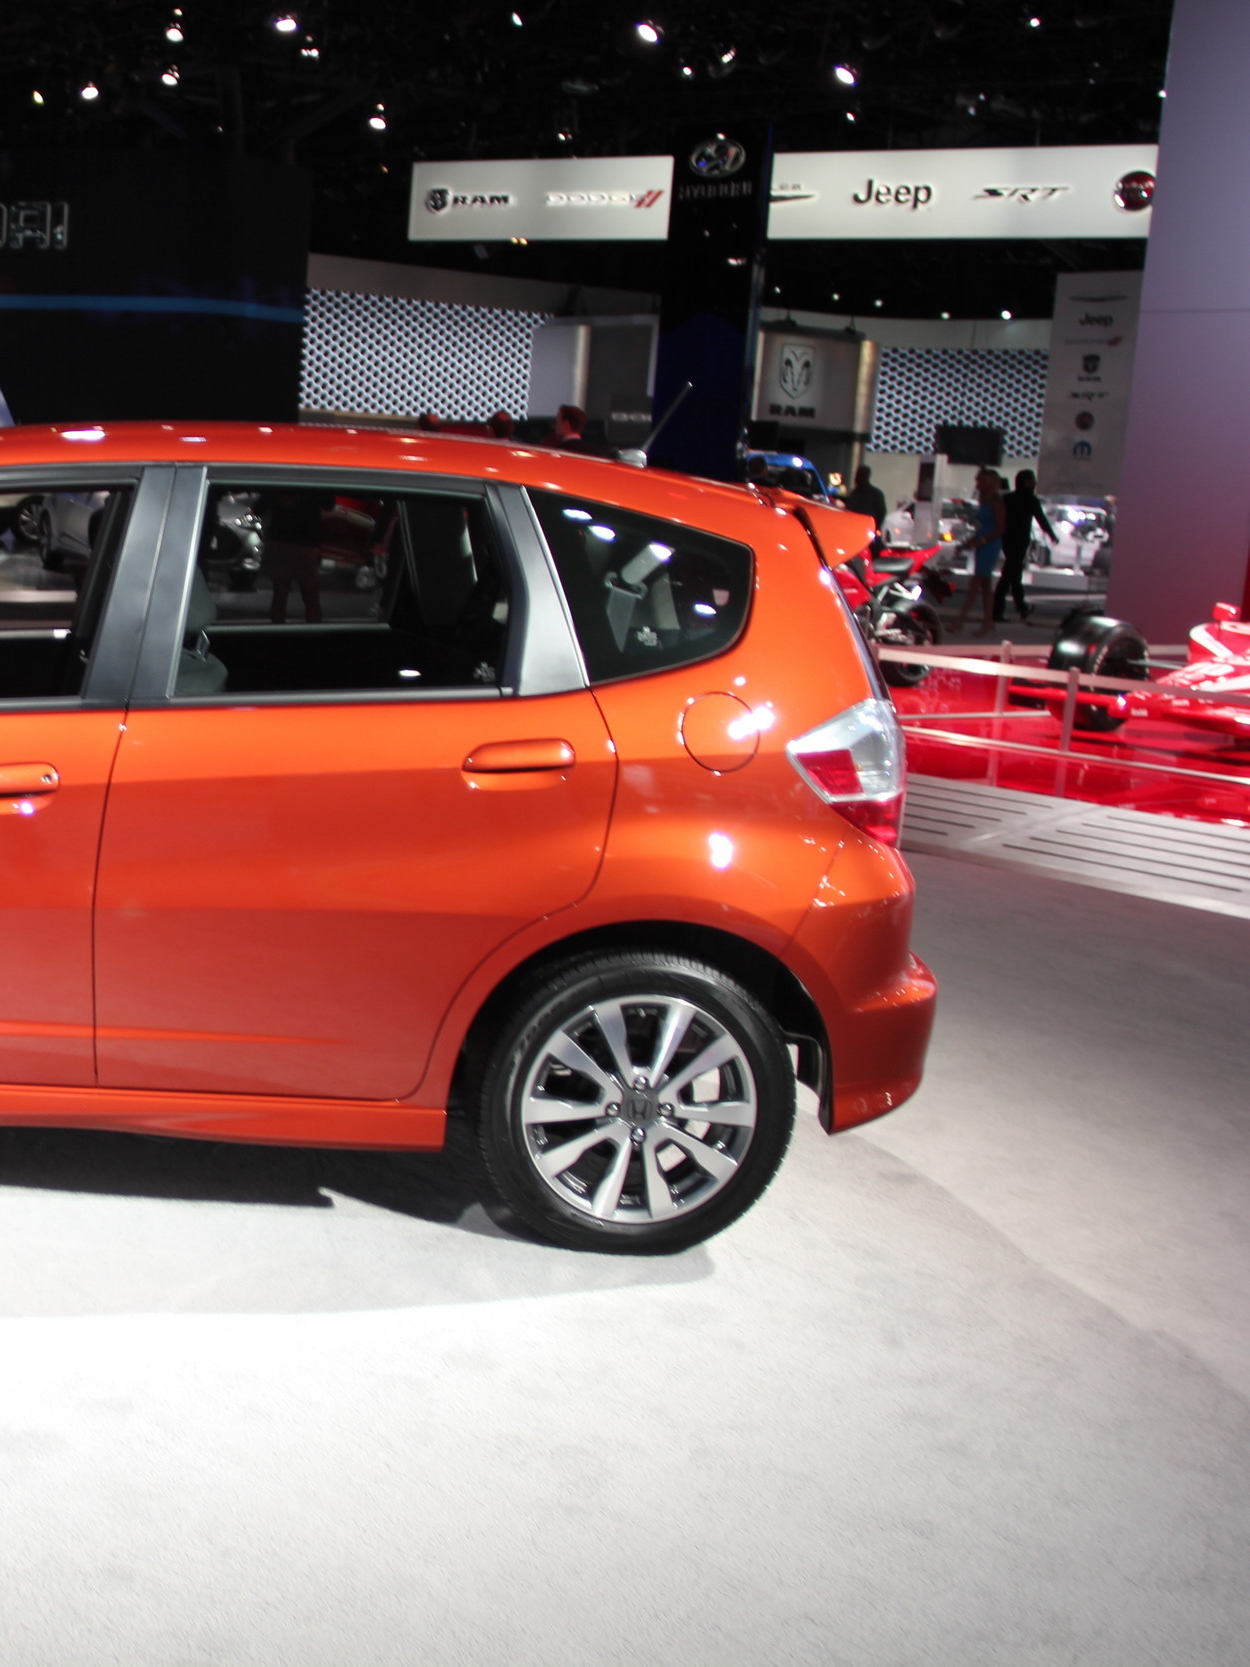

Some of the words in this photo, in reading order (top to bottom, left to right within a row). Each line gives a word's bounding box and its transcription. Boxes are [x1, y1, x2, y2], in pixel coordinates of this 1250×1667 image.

[452, 194, 511, 206] RAM
[546, 189, 640, 208] DODG
[852, 178, 932, 210] Jeep
[974, 186, 1069, 203] SRT
[1078, 312, 1114, 328] Jeep
[768, 403, 816, 418] RAM
